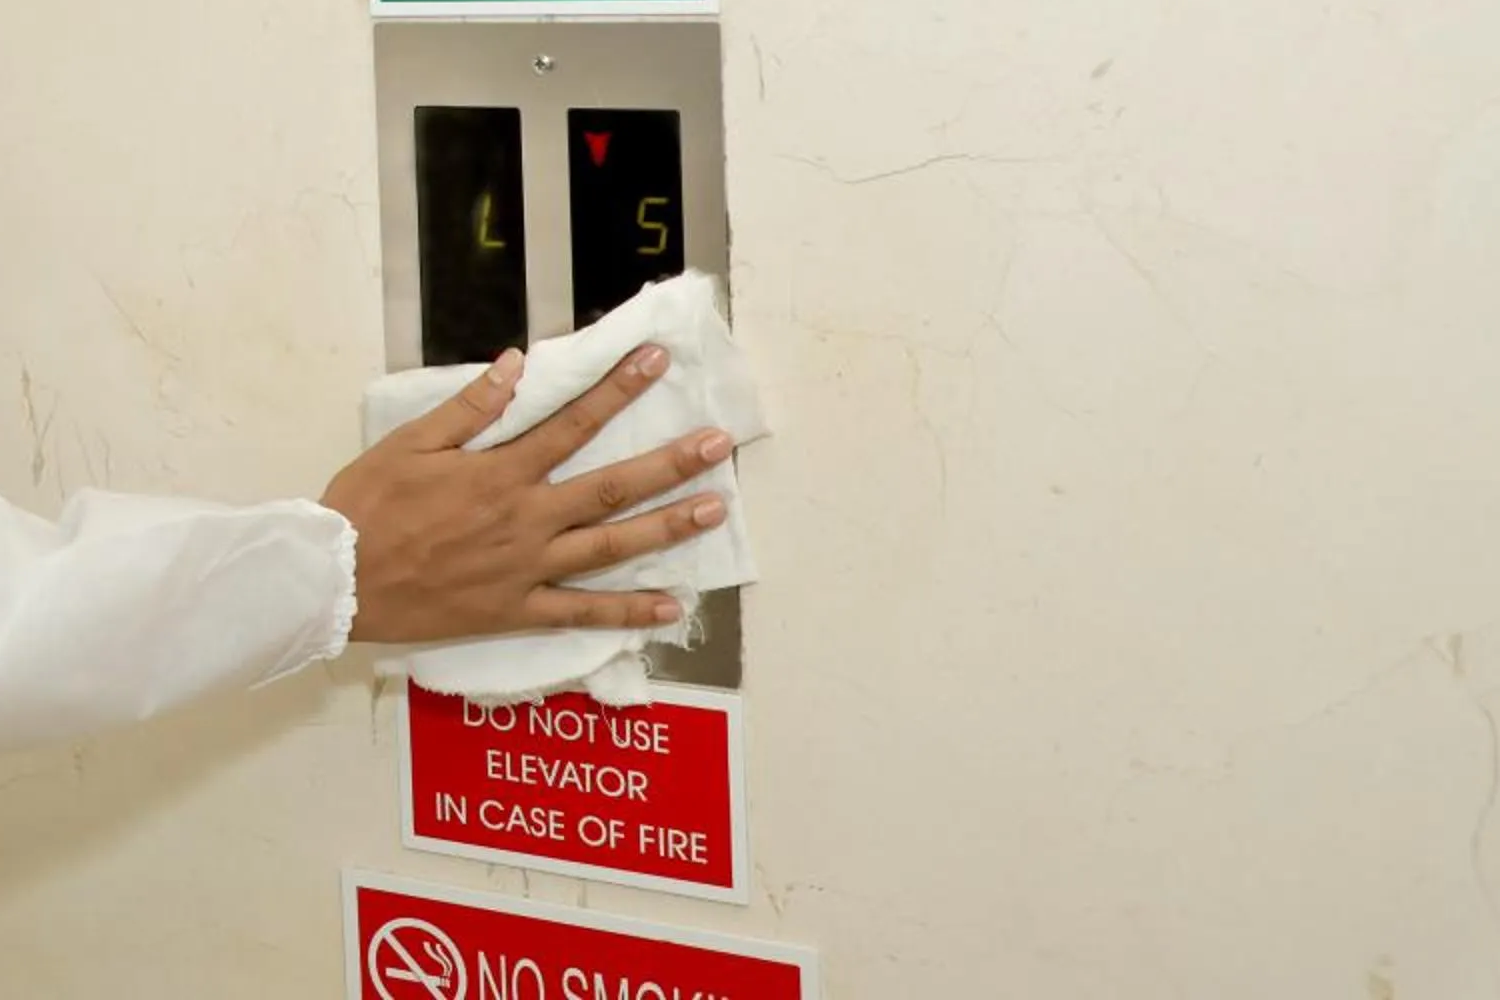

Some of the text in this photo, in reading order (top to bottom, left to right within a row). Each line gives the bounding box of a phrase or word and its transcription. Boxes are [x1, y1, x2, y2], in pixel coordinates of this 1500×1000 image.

[478, 193, 507, 249] L
[463, 700, 671, 754] DO NOT USE
[486, 749, 648, 801] ELEVATOR
[435, 791, 708, 864] IN CASE OF FIRE
